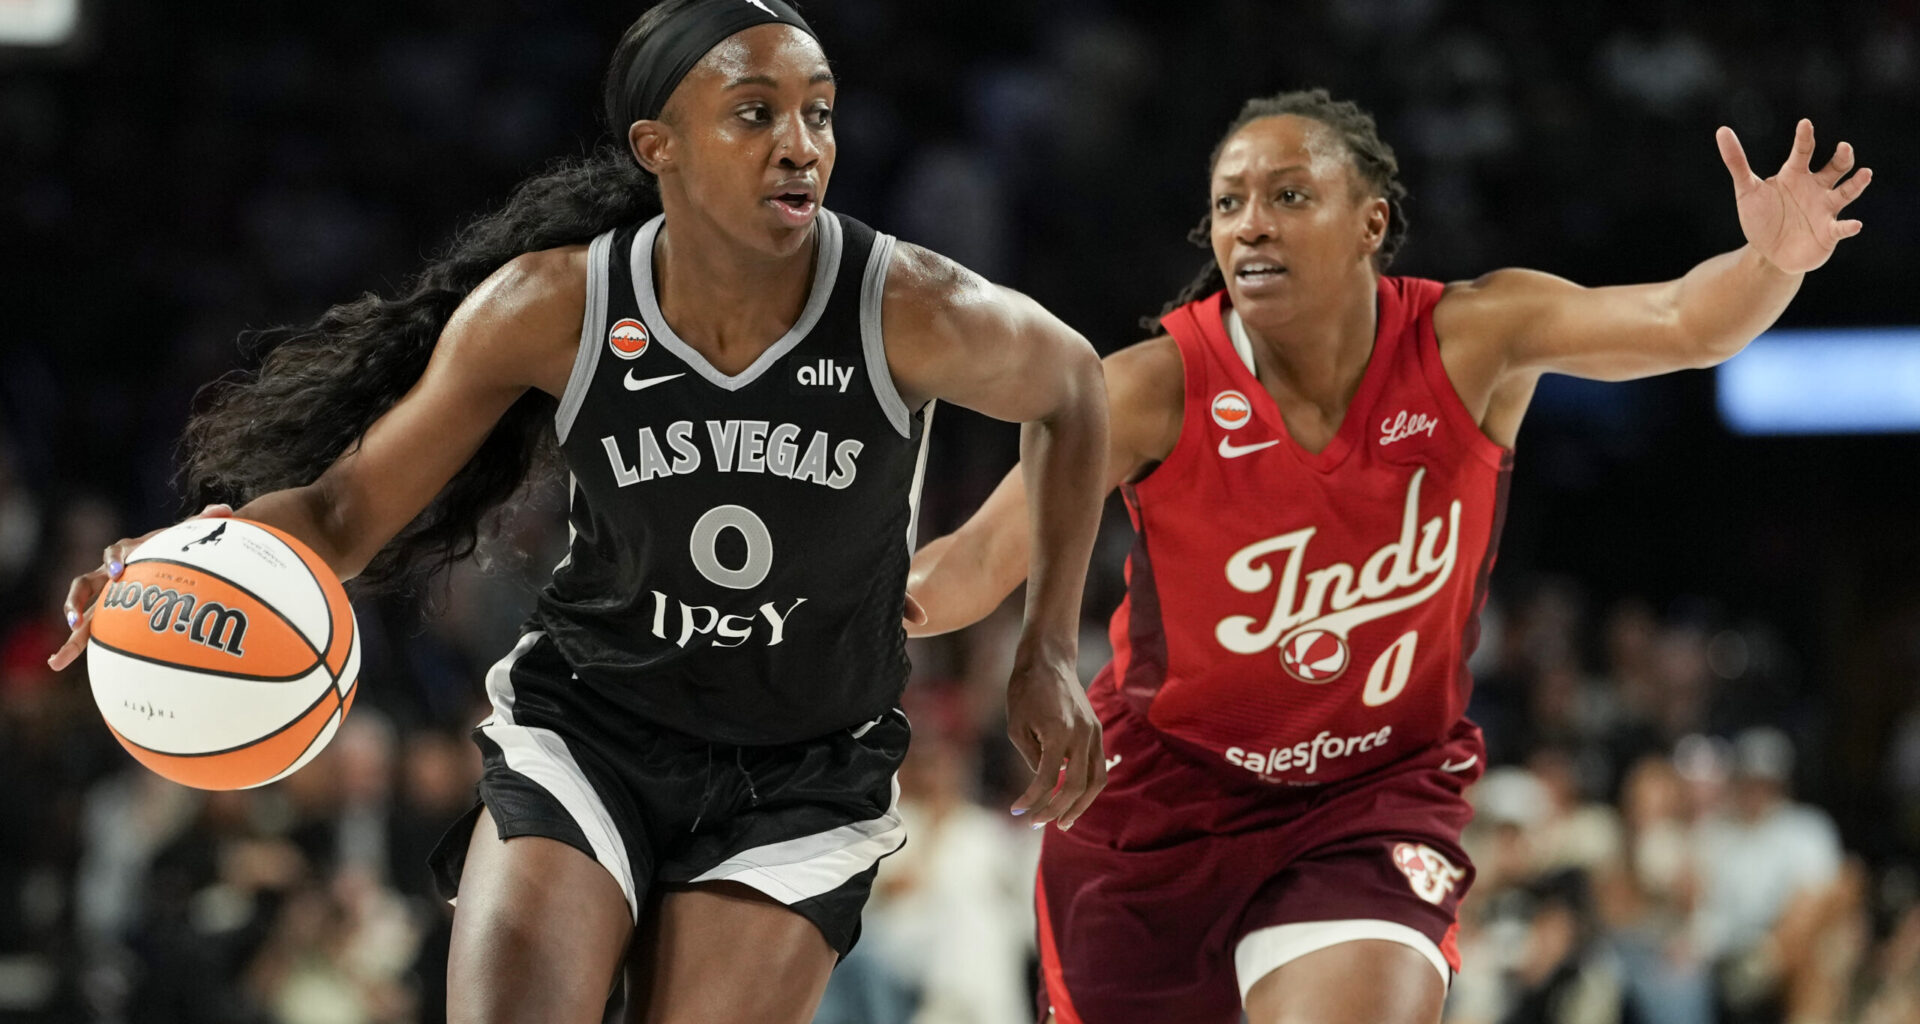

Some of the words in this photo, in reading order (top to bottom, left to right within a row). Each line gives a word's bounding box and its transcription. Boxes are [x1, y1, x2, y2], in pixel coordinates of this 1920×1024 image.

[796, 359, 854, 393] ally
[601, 420, 701, 488] LAS
[706, 420, 864, 490] VEGAS
[1379, 410, 1439, 446] Lilly
[690, 504, 773, 590] 0
[1215, 467, 1461, 654] Indy
[103, 580, 249, 659] Wilson
[1362, 630, 1419, 707] 0
[1225, 725, 1392, 774] salesforce
